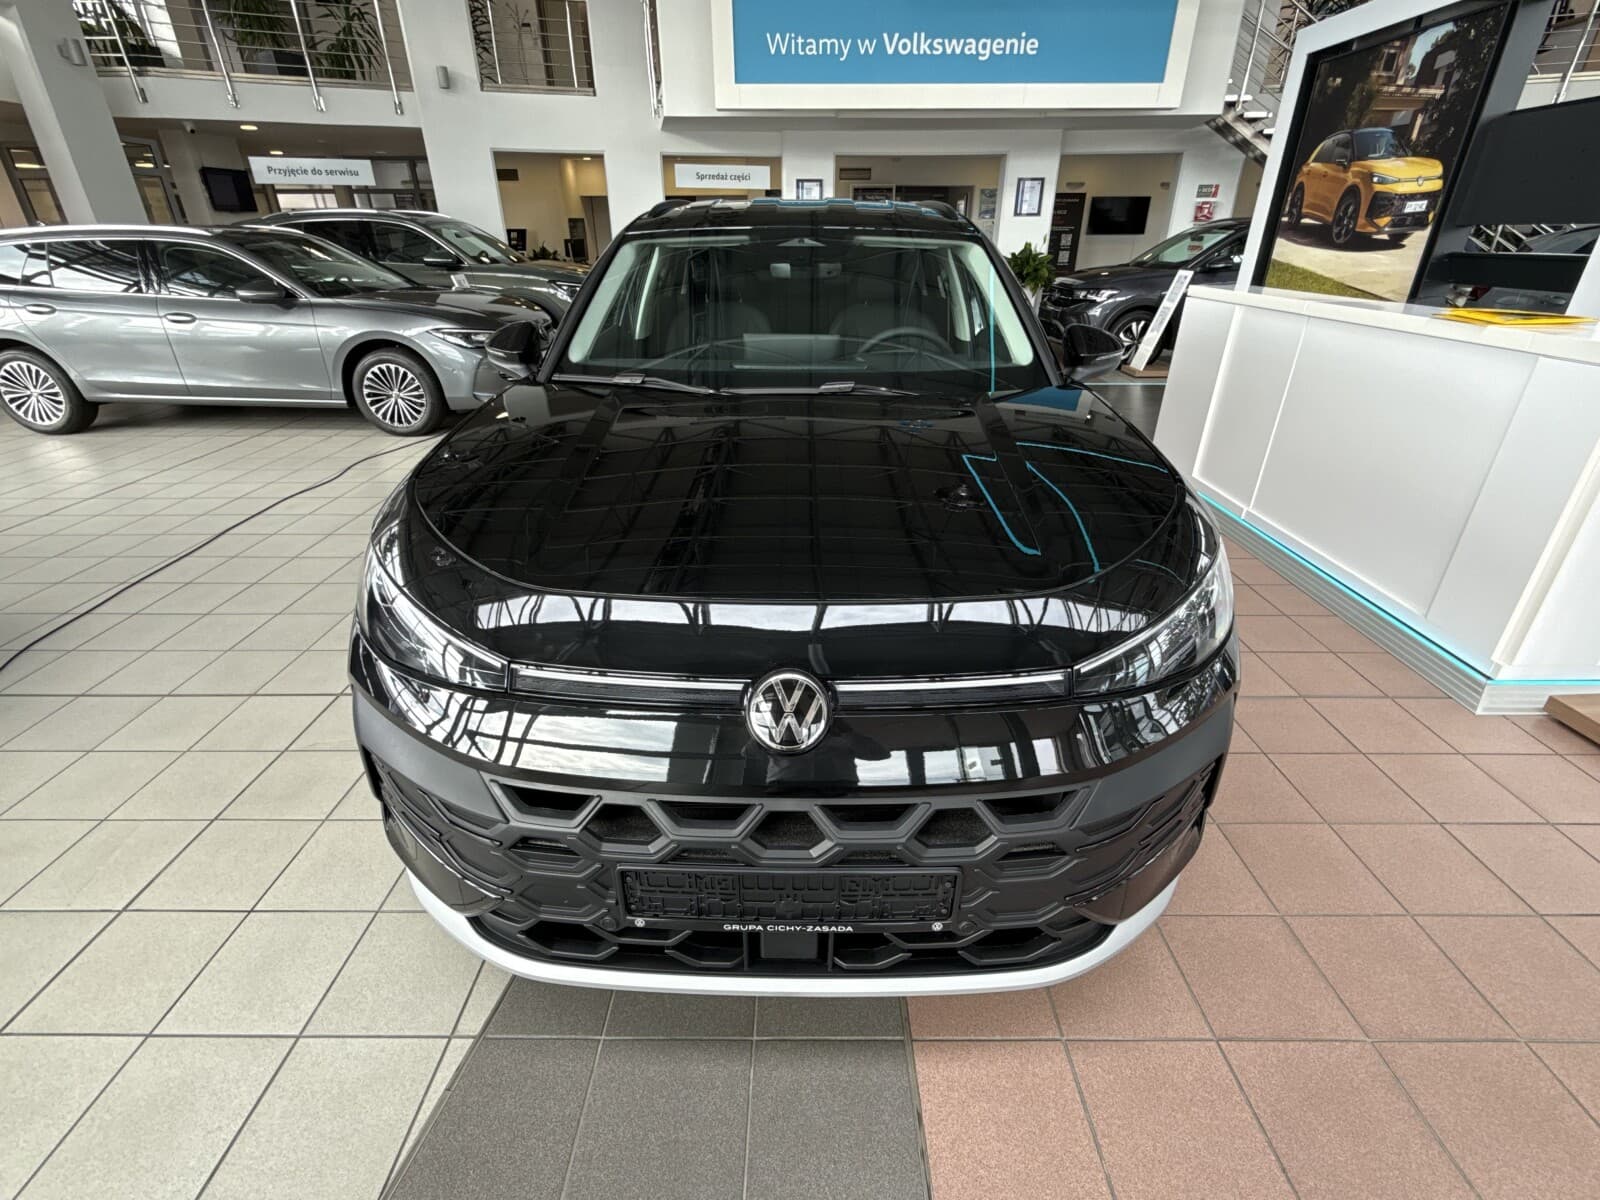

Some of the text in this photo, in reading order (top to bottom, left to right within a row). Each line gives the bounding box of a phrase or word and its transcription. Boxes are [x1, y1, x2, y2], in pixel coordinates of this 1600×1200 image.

[766, 32, 1039, 61] Witamy w Volkswagenie
[266, 165, 360, 178] Przyjęcie do serwisu
[695, 171, 751, 182] Sprzedaż części
[766, 924, 854, 932] CICHY-ZASADA
